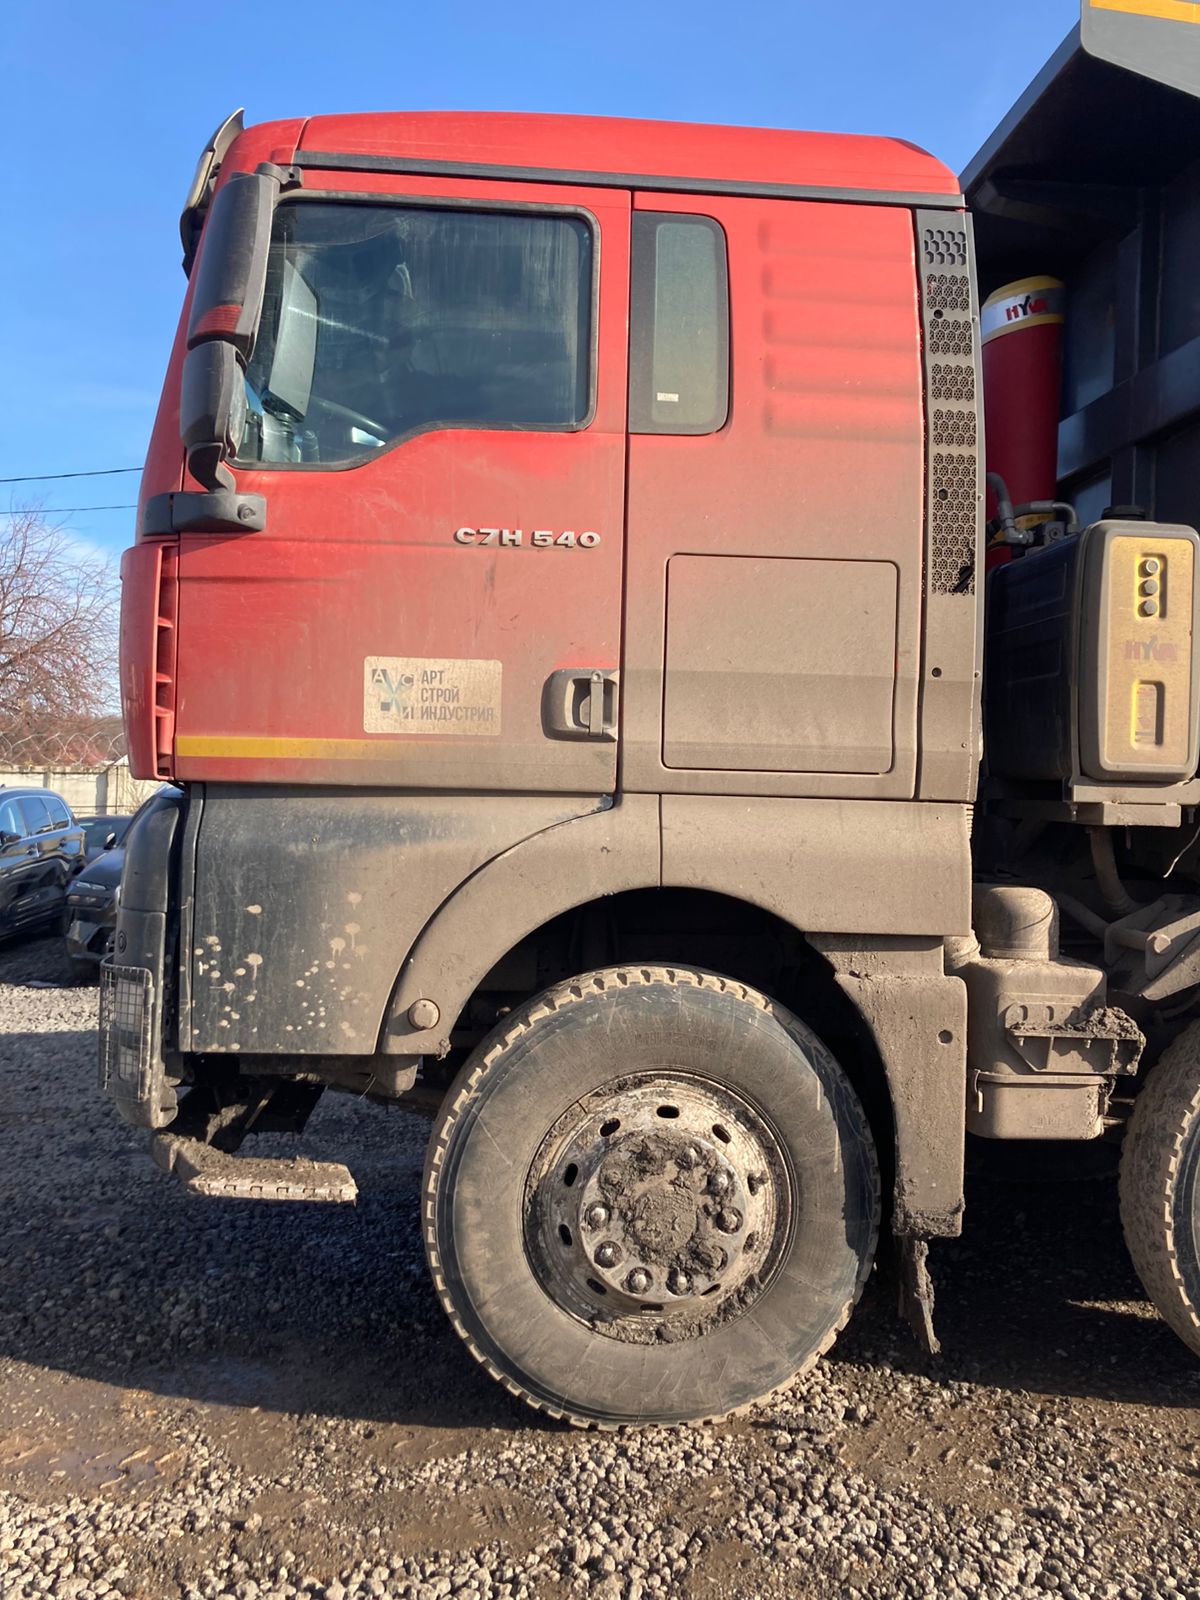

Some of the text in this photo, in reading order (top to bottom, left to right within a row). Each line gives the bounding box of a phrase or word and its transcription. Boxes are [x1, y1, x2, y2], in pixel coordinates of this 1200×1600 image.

[455, 527, 601, 549] C7H 540
[421, 670, 444, 684] АРТ
[421, 685, 460, 703] СТРОЙ
[421, 706, 494, 721] ИНДУСТРИЯ
